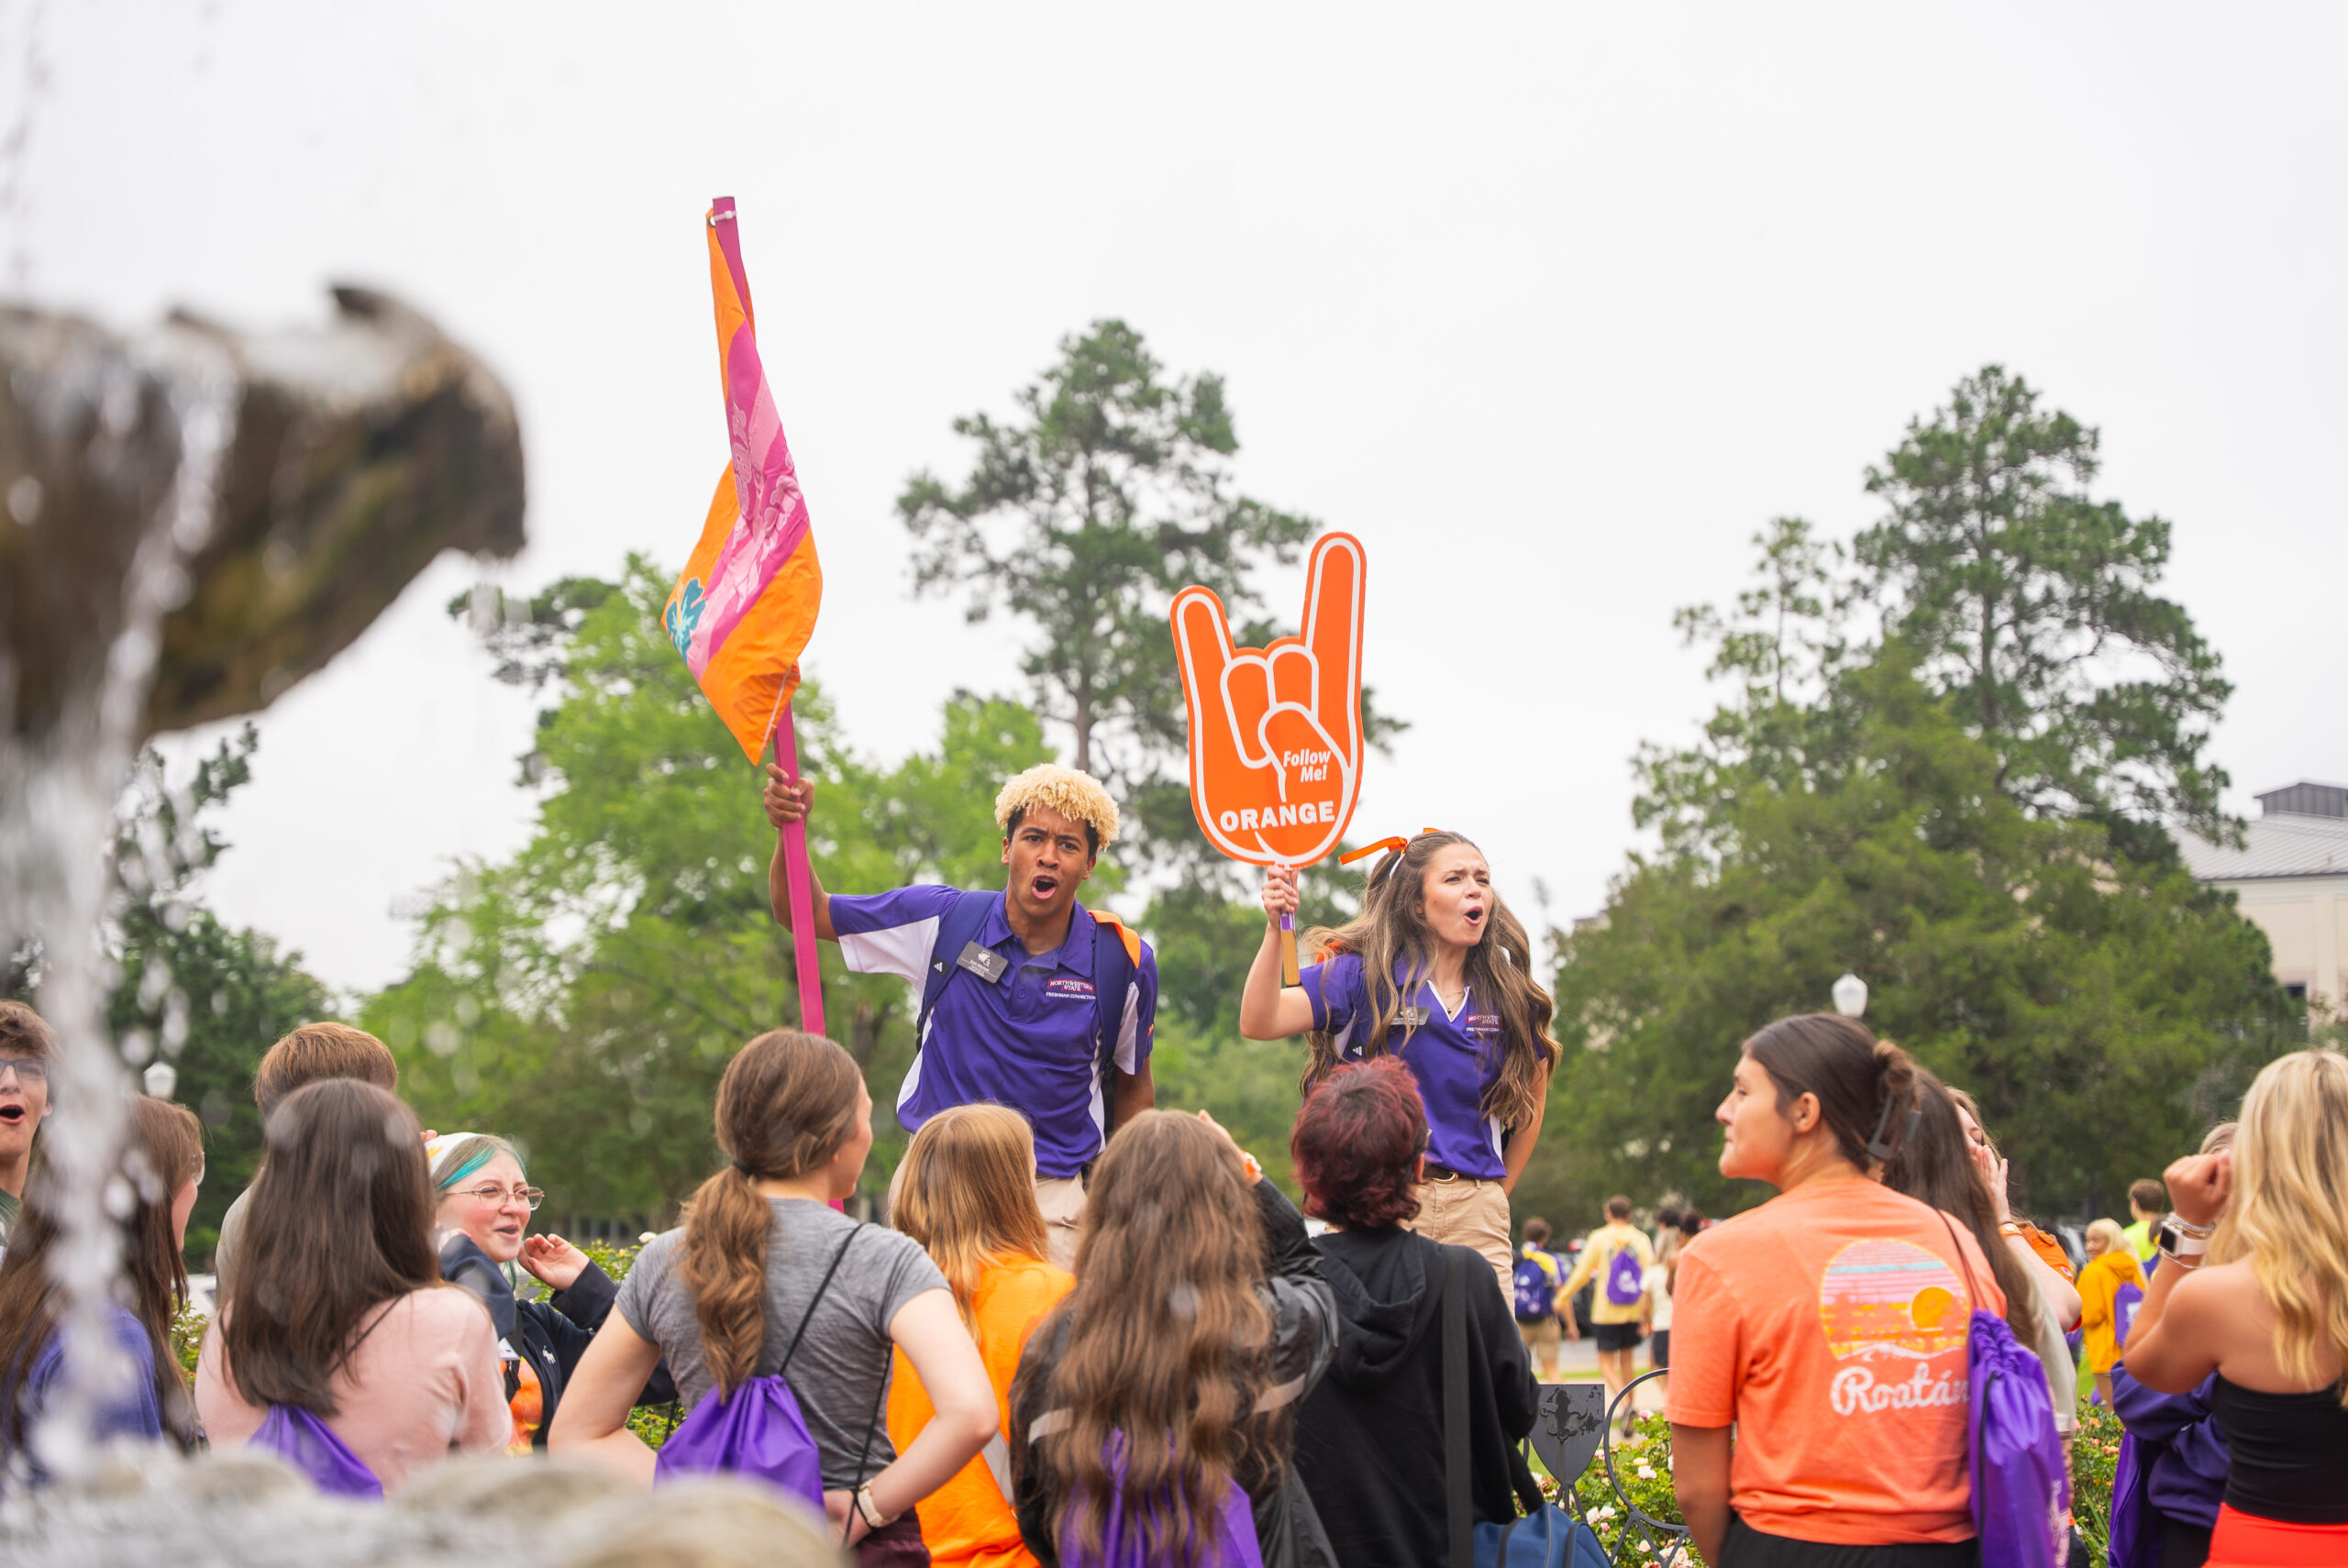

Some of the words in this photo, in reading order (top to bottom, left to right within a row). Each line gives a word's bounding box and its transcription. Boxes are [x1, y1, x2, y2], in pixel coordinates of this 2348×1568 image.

[1283, 748, 1331, 767] Follow
[1301, 766, 1327, 782] Me!
[1220, 801, 1335, 833] ORANGE
[1049, 980, 1093, 990] NORTHWESTERN
